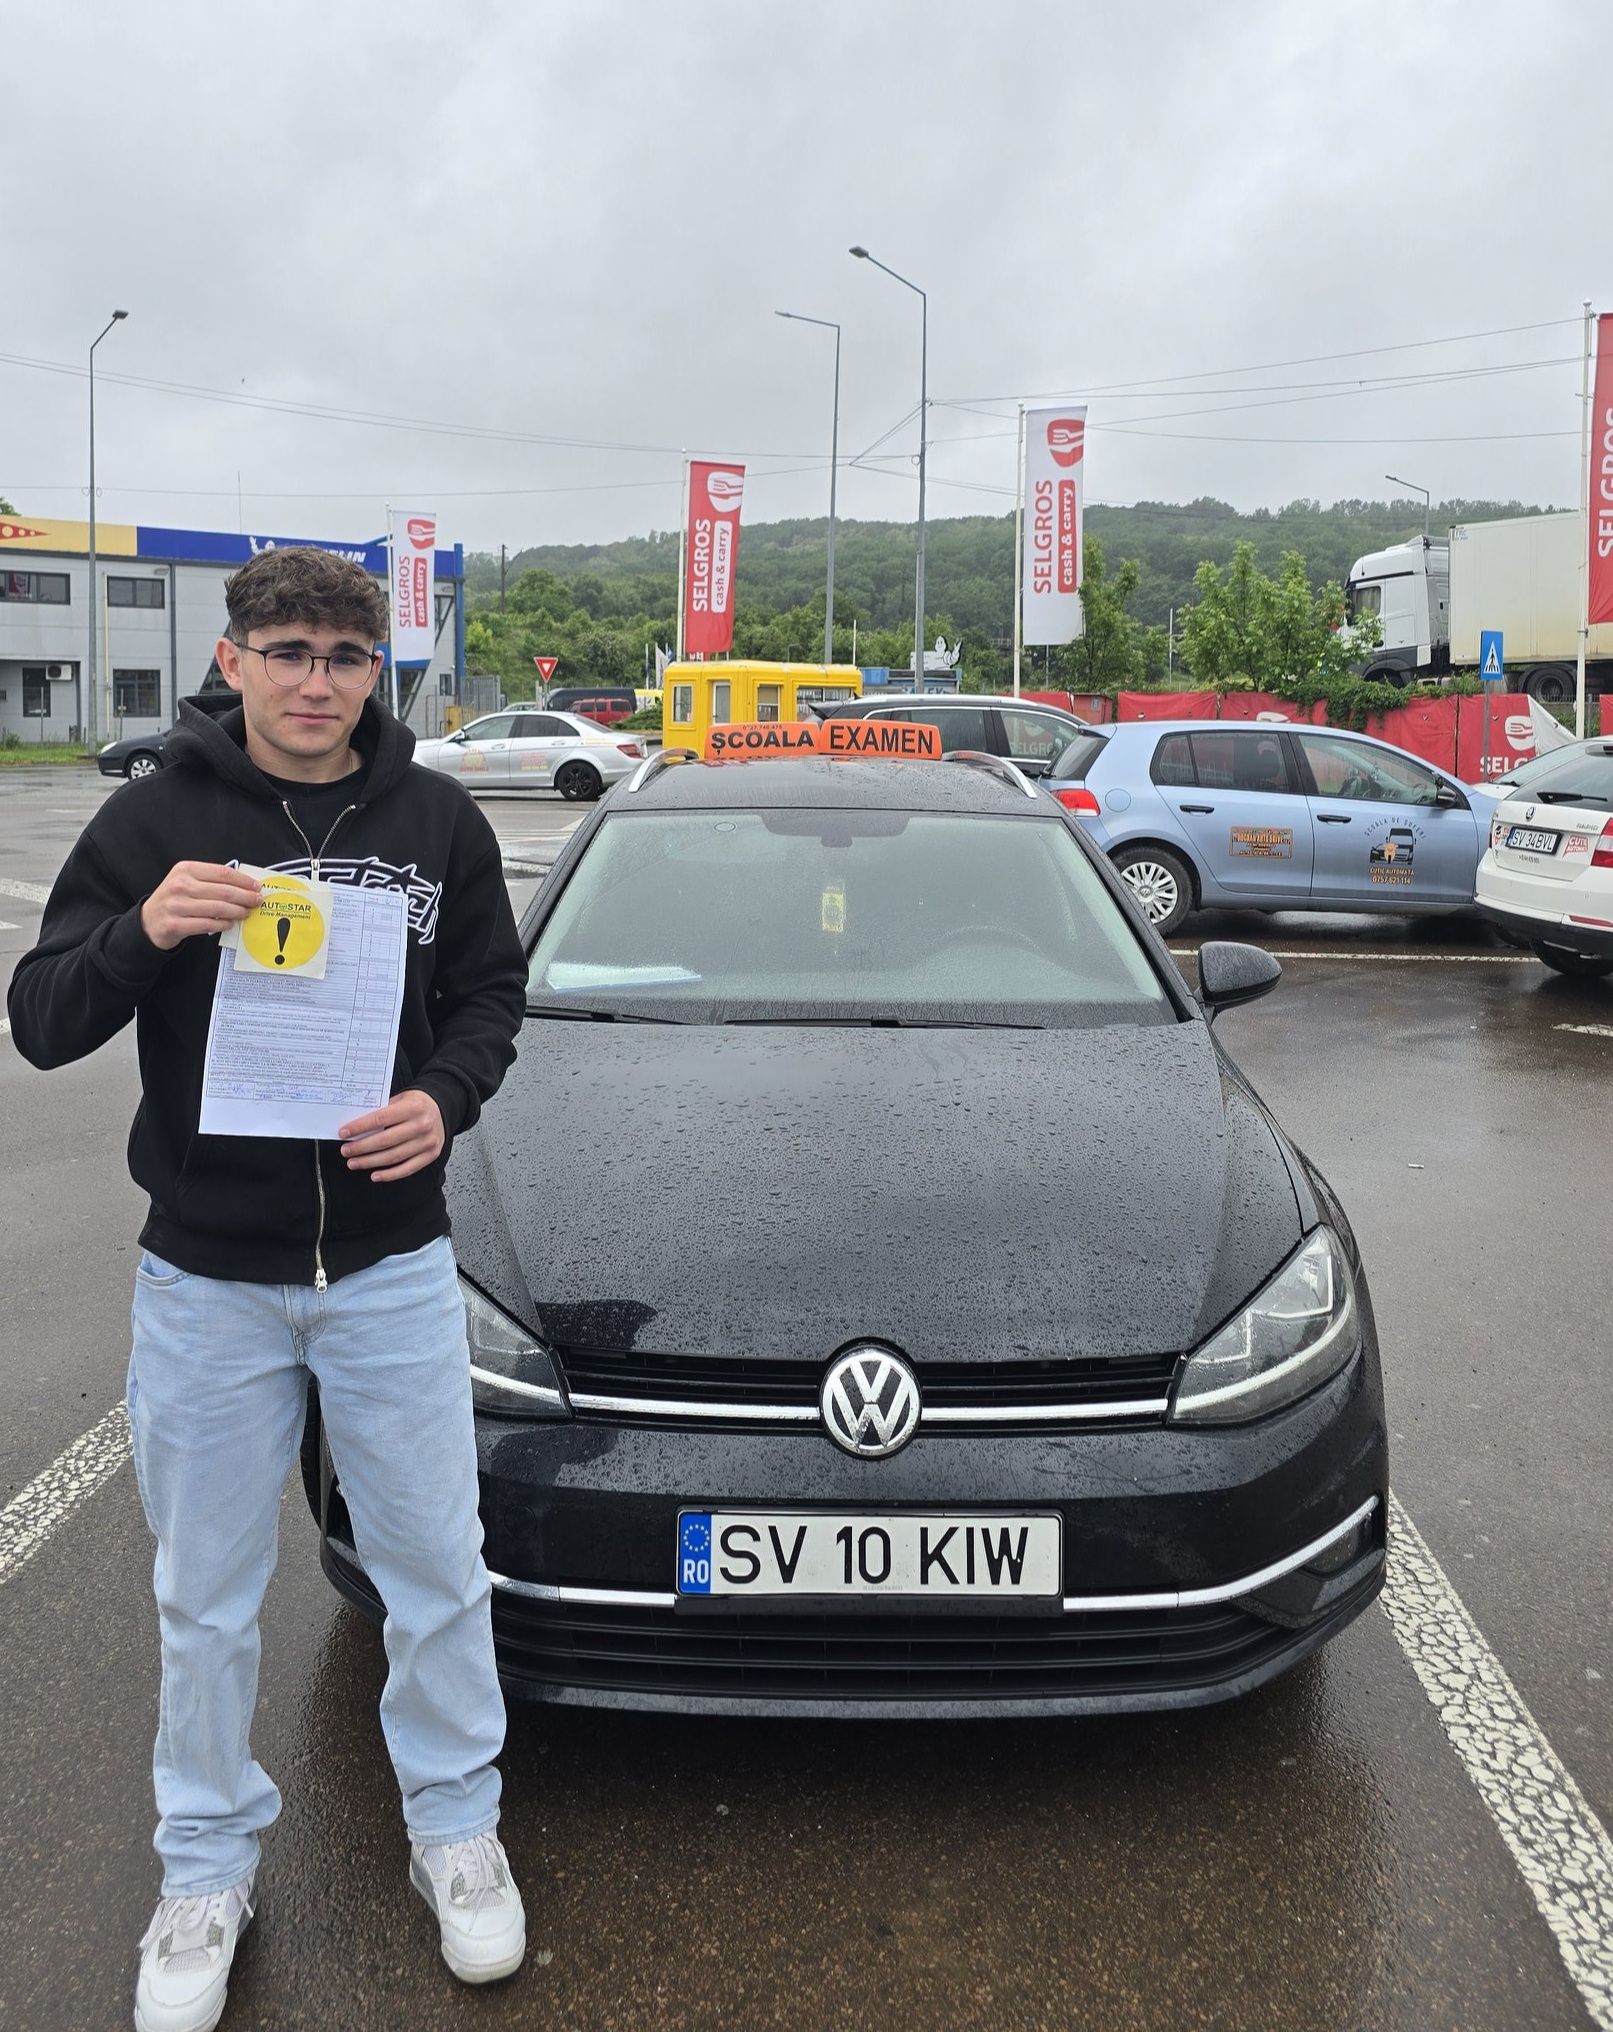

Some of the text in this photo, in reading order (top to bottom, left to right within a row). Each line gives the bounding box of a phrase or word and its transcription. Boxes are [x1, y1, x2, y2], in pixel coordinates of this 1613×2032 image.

[692, 519, 711, 612] SELGROS
[715, 527, 730, 606] cash & carry
[1033, 479, 1053, 594] SELGROS
[1061, 487, 1074, 586] cash & carry
[398, 555, 411, 628] SELGROS
[417, 561, 426, 589] carry
[415, 600, 425, 623] cash
[829, 725, 933, 754] EXAMEN
[1512, 831, 1526, 846] SV
[275, 912, 312, 920] Management
[682, 1524, 1030, 1586] RO SV 10 KIW
